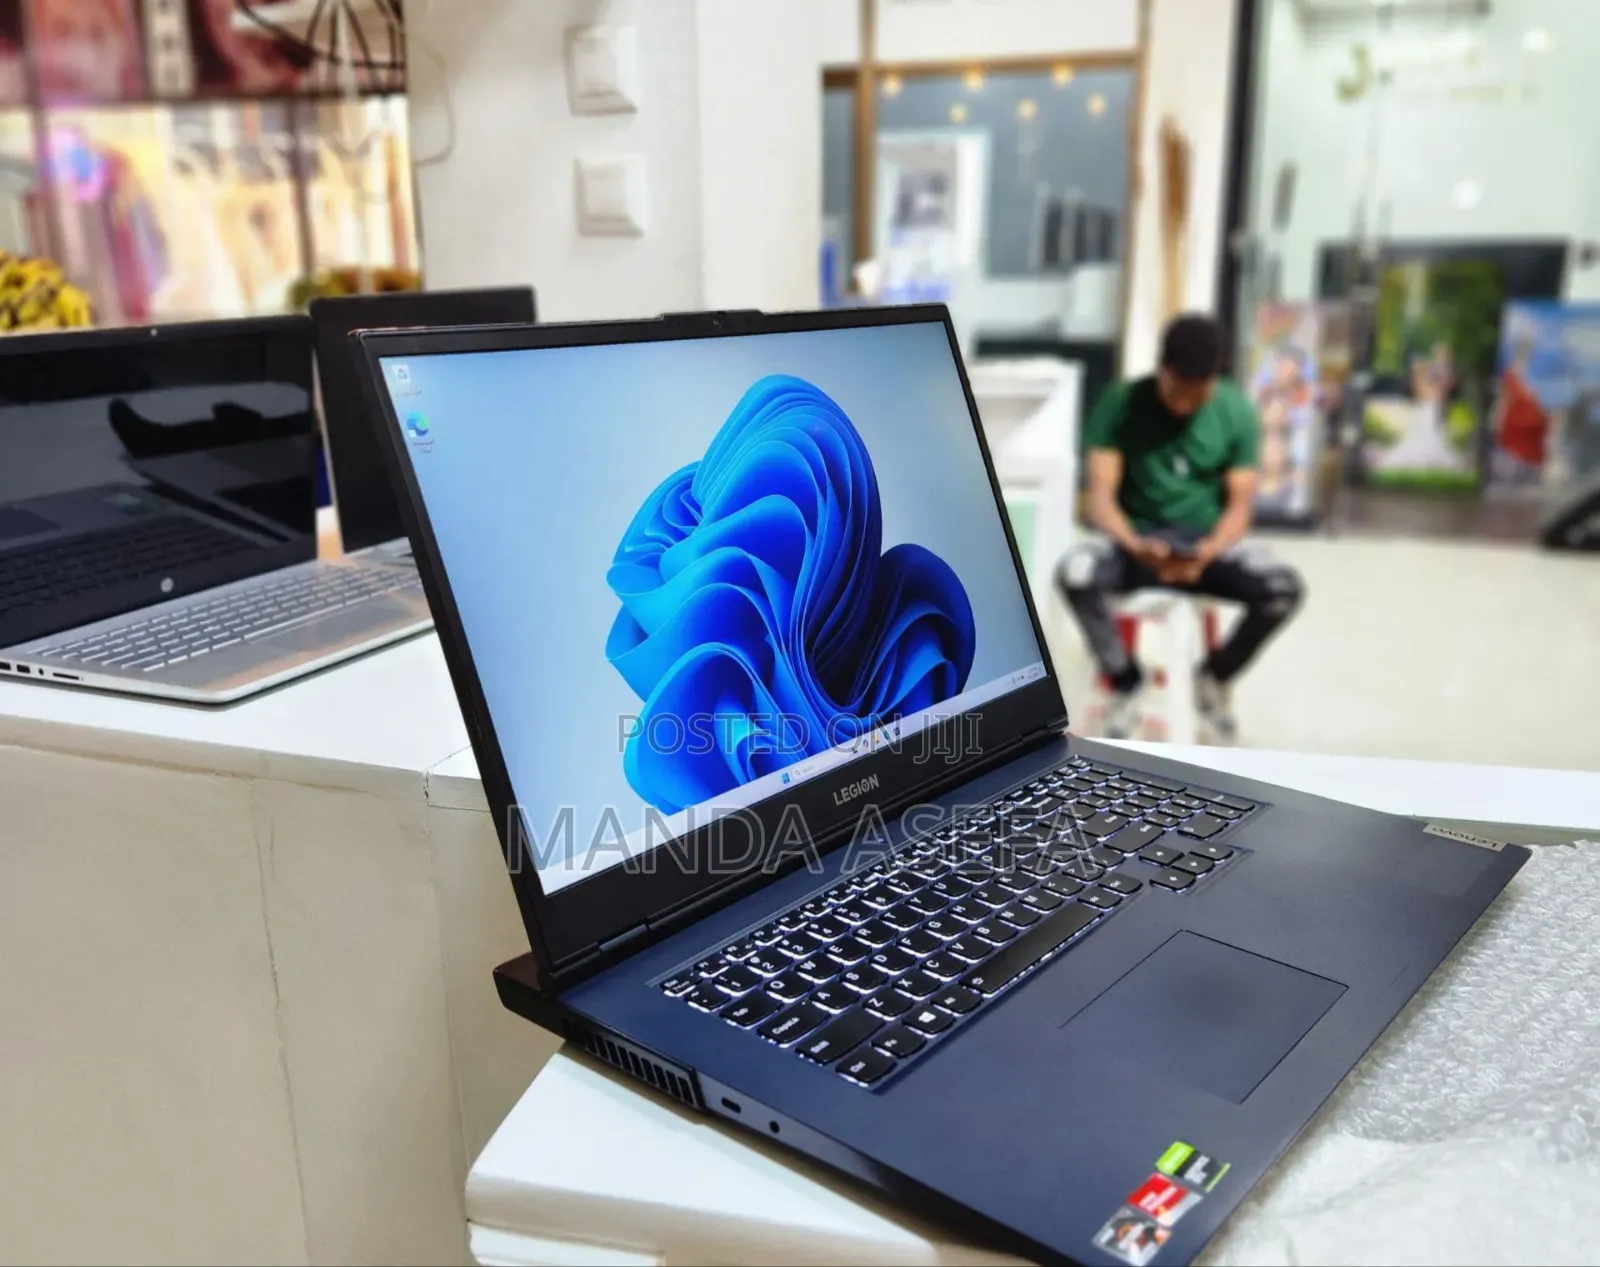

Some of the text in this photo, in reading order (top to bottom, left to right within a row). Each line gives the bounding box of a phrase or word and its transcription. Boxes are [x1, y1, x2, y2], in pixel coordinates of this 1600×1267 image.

[832, 773, 880, 807] LEGION
[934, 882, 948, 890] U
[909, 896, 922, 904] Y
[1023, 894, 1039, 903] M
[952, 905, 966, 913] H
[884, 911, 897, 919] T
[1001, 910, 1015, 919] N
[928, 920, 942, 929] G
[823, 927, 833, 935] 4
[857, 928, 872, 937] R
[976, 926, 991, 935] B
[901, 937, 912, 946] F
[951, 942, 965, 950] V
[792, 944, 804, 952] 3
[829, 944, 843, 954] E
[873, 954, 888, 963] D
[762, 961, 775, 970] 2
[800, 960, 817, 970] W
[926, 959, 940, 969] C
[845, 971, 860, 981] S
[897, 978, 913, 988] X
[816, 991, 831, 1001] A
[868, 996, 884, 1008] Z
